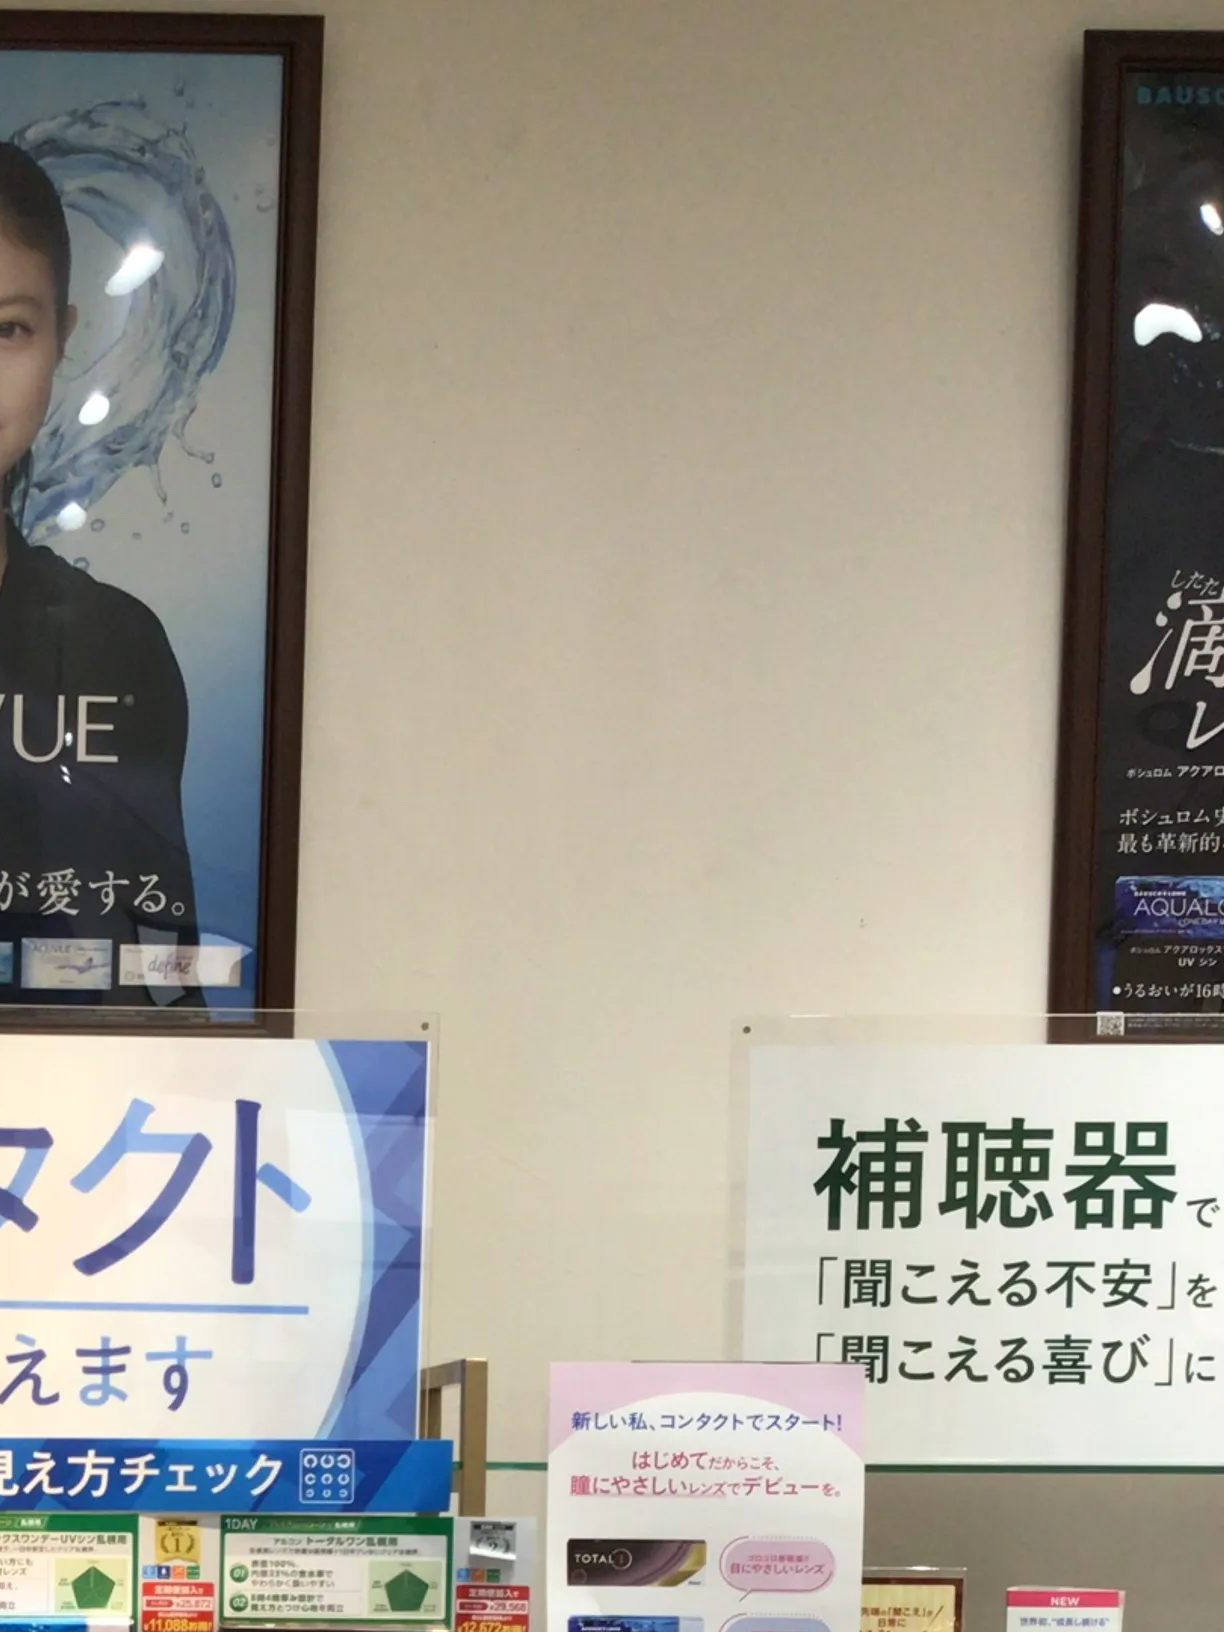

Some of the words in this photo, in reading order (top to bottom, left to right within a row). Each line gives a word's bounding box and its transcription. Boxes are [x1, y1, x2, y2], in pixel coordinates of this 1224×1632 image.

[1117, 832, 1224, 853] 最も革新的
[819, 1257, 1218, 1310] 「聞こえる不安」を
[633, 1451, 780, 1470] はじめてだからこそ、
[225, 1519, 257, 1529] 1DAY
[1050, 1597, 1079, 1606] NEW
